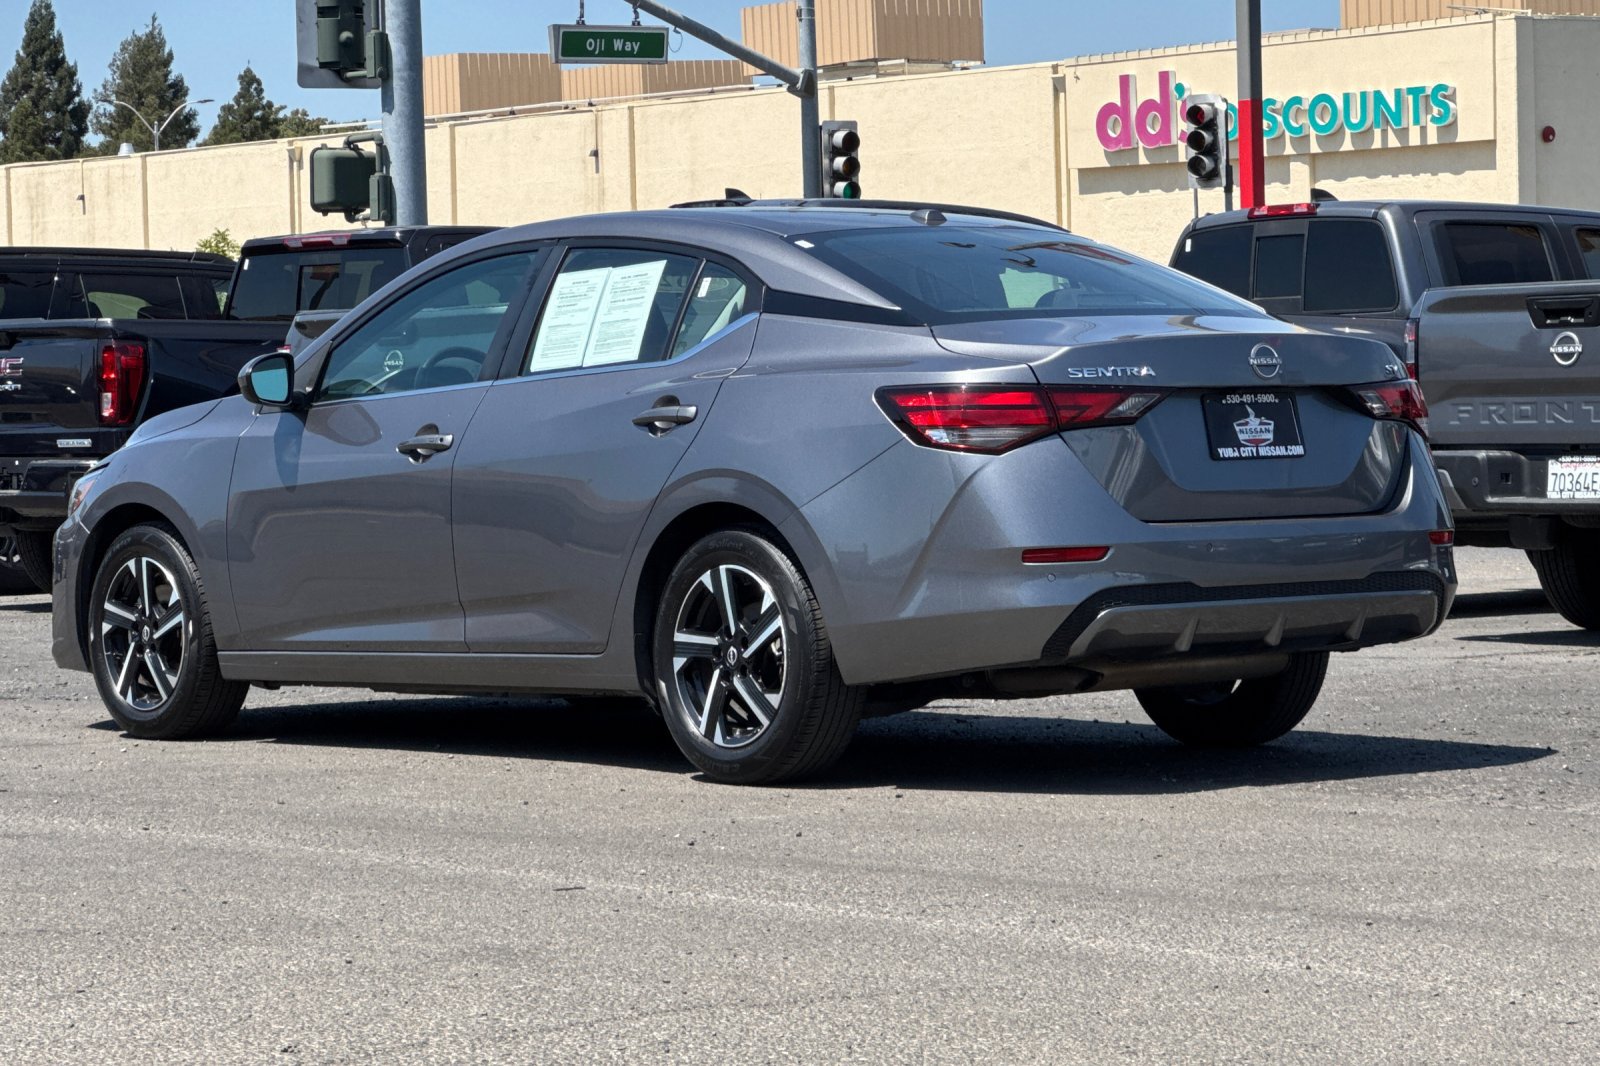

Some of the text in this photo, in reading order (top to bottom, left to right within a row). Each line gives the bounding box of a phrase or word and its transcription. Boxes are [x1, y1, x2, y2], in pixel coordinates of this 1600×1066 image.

[613, 38, 640, 54] Way
[1550, 345, 1583, 353] NISSAN
[1249, 357, 1282, 365] NISSAN
[1067, 366, 1156, 378] SENTRA
[1239, 427, 1271, 435] NISSAN
[1217, 444, 1305, 458] YUBA CITY NISSAN.COM
[1551, 472, 1599, 491] 70364E
